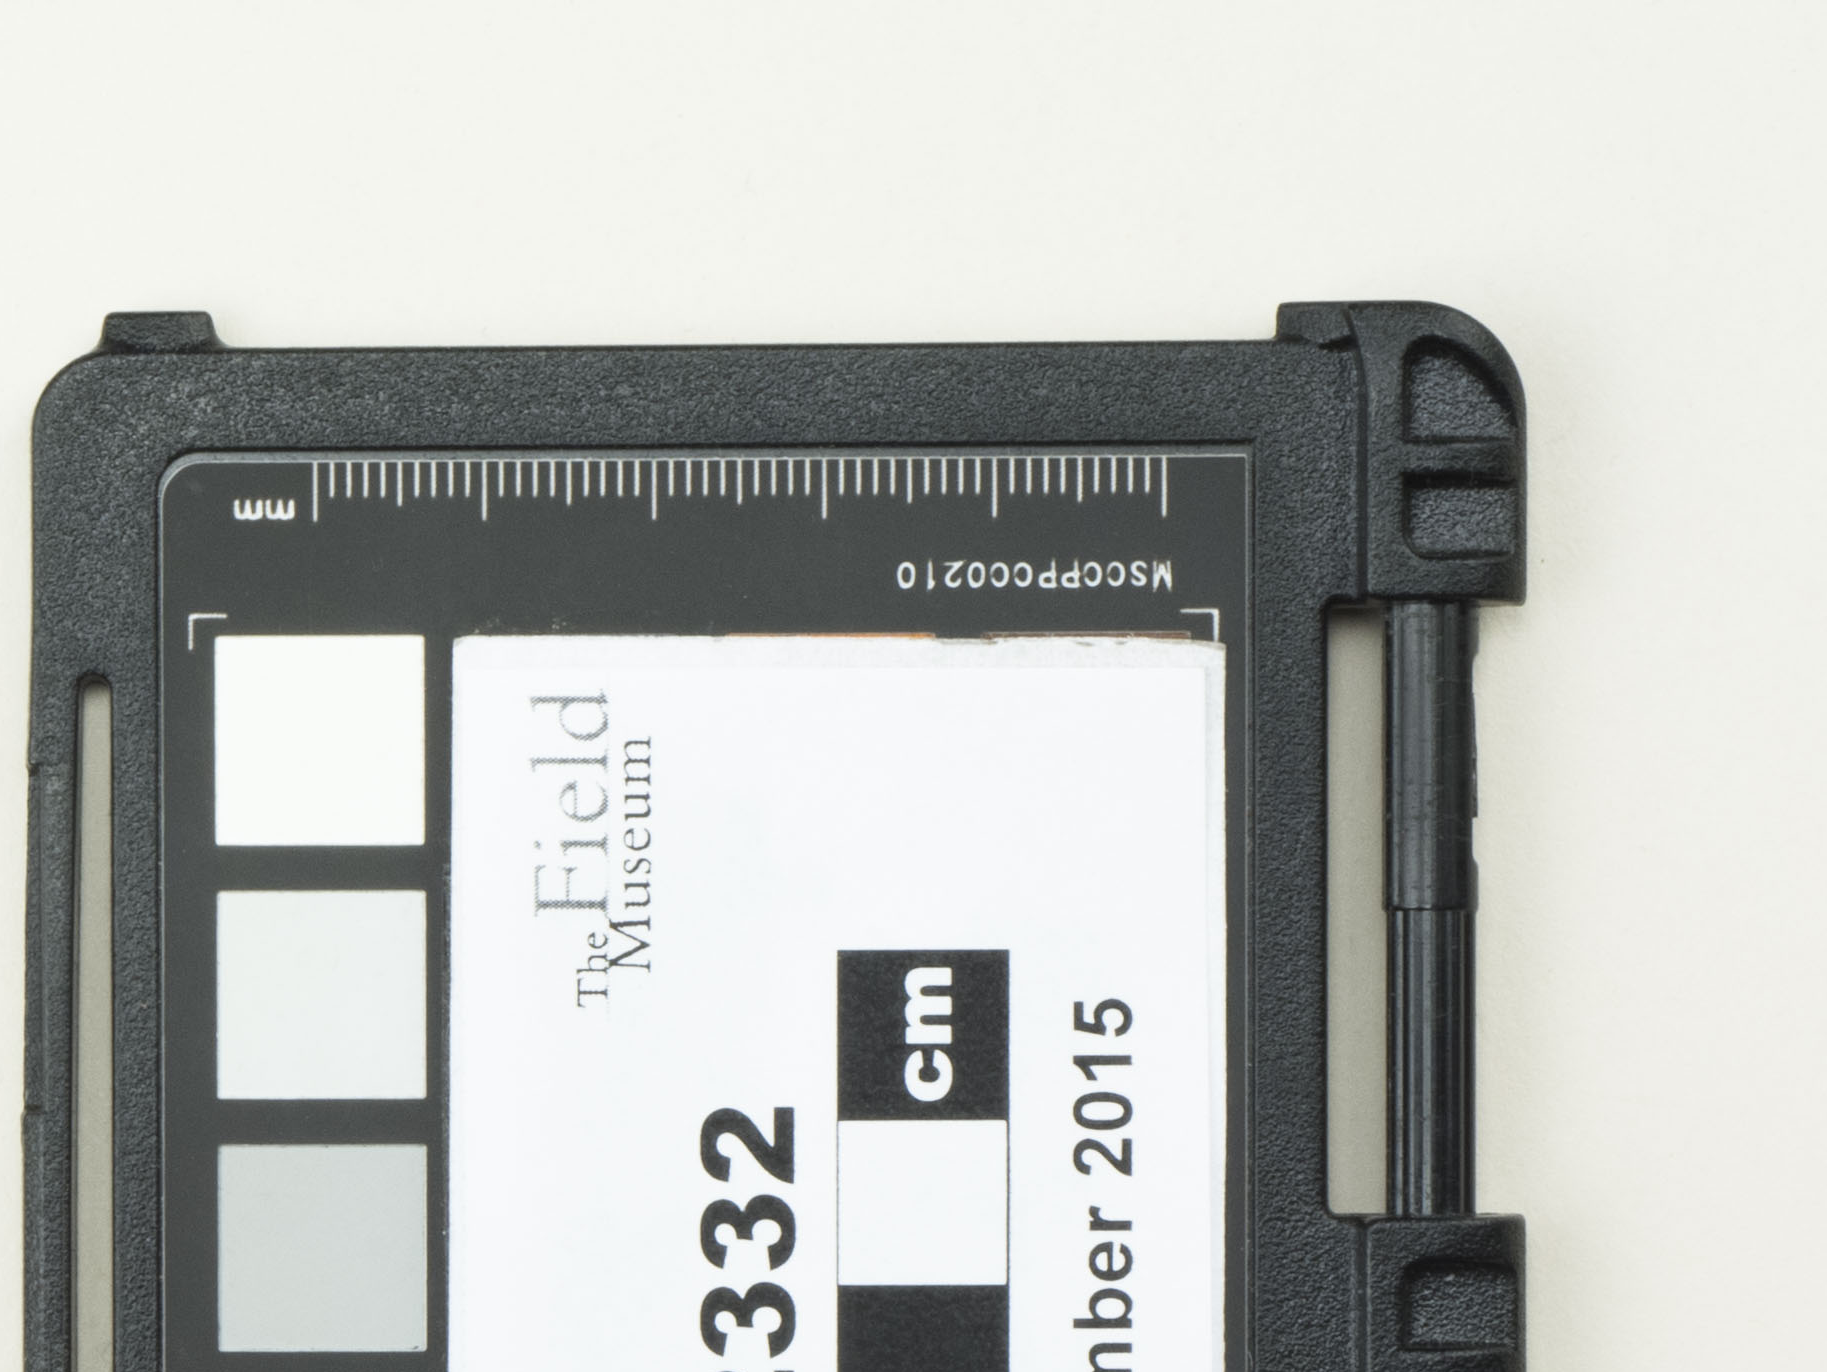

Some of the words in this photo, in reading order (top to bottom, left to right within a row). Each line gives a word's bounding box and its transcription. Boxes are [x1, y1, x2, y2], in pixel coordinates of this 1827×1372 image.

[232, 497, 298, 521] mm
[530, 692, 610, 915] Field
[607, 735, 652, 973] Museum
[575, 932, 610, 1009] The
[902, 966, 955, 1102] cm
[1072, 998, 1134, 1177] 2015
